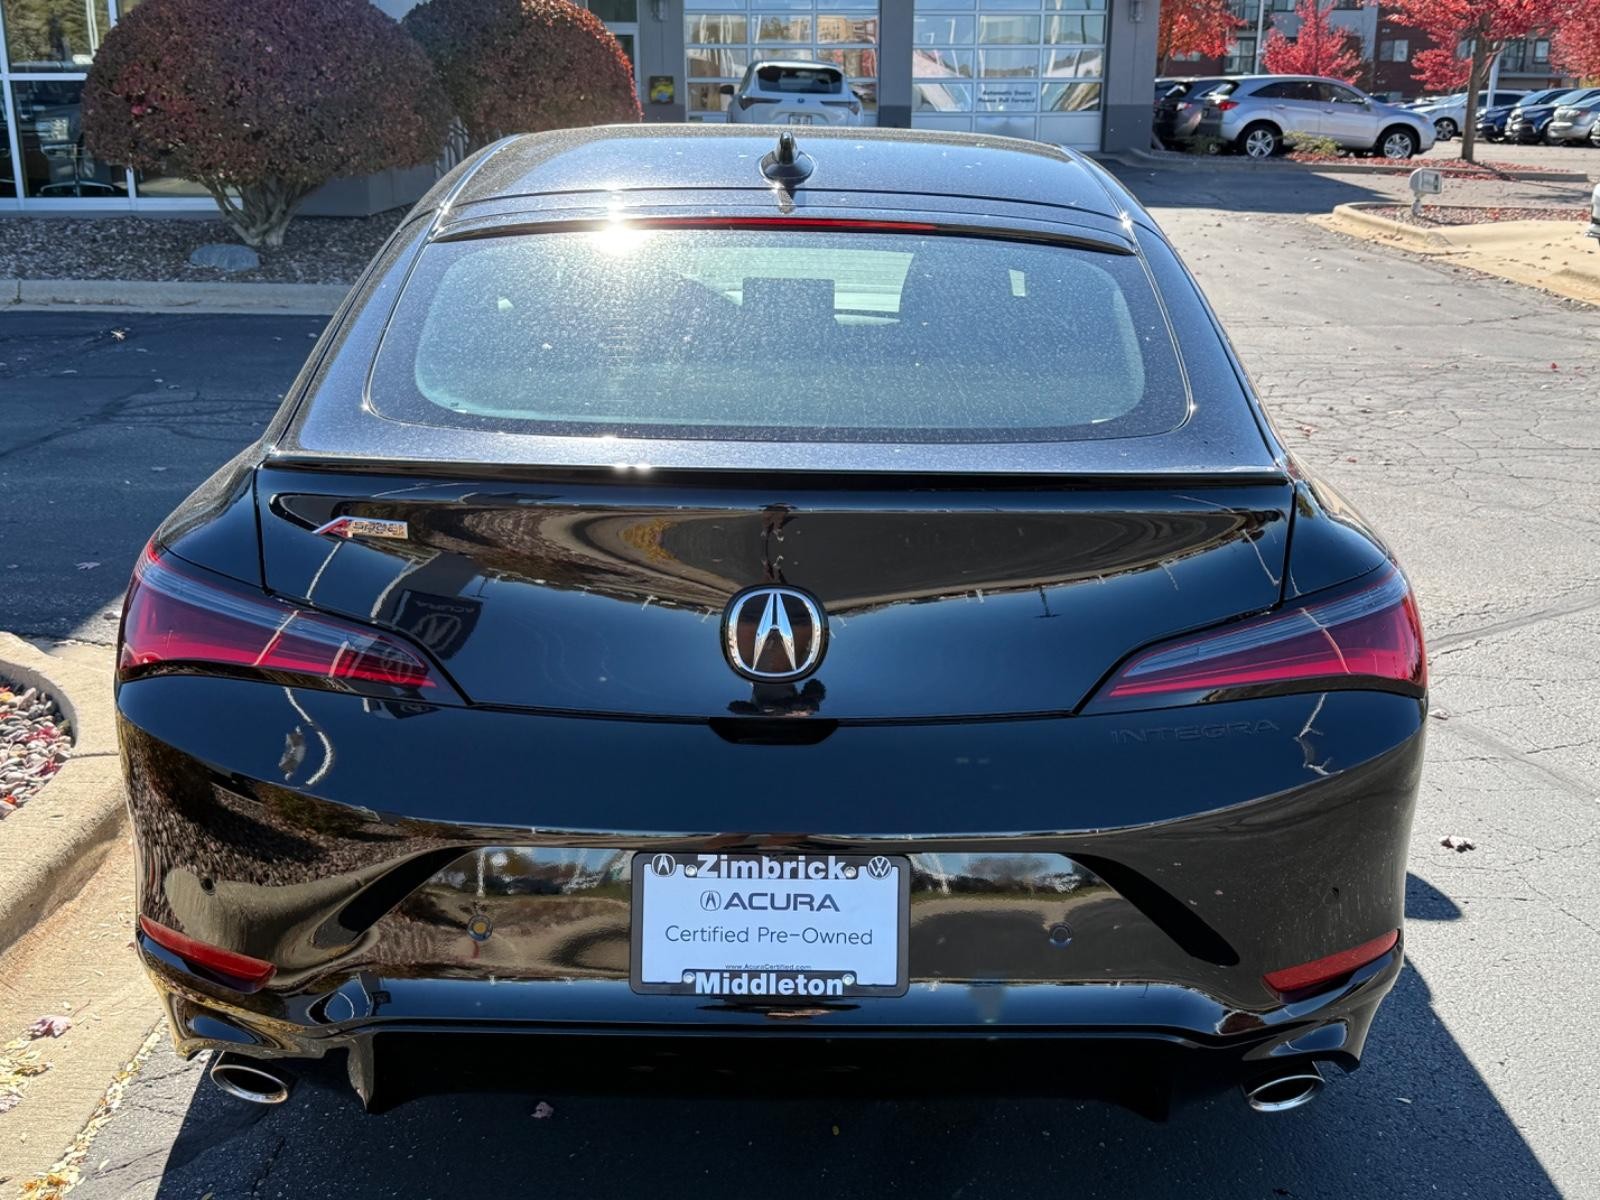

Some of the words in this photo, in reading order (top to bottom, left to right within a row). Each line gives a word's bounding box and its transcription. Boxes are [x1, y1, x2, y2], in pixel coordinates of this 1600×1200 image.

[1109, 719, 1281, 745] INTEGRA
[697, 854, 847, 880] Zimbrick
[723, 892, 841, 912] ACURA
[665, 924, 749, 943] Certified
[757, 926, 873, 946] Pre-Owned
[695, 971, 844, 996] Middleton
